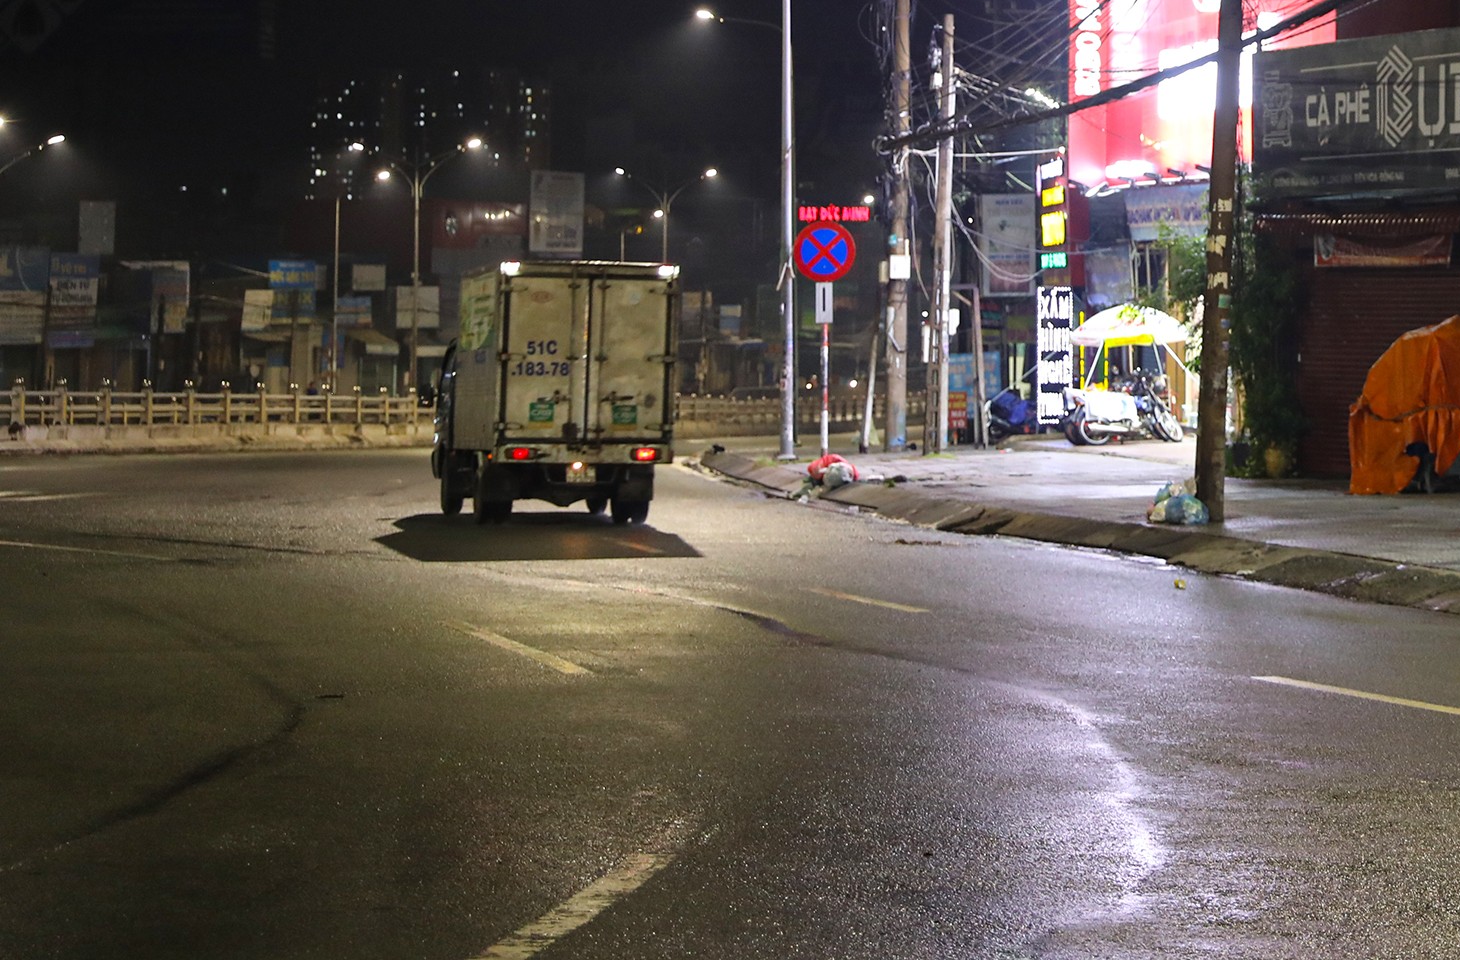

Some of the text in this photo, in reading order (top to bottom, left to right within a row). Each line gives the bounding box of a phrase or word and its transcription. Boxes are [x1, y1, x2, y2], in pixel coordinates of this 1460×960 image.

[1305, 83, 1371, 128] CÀ PHÊ
[527, 340, 558, 355] 51C
